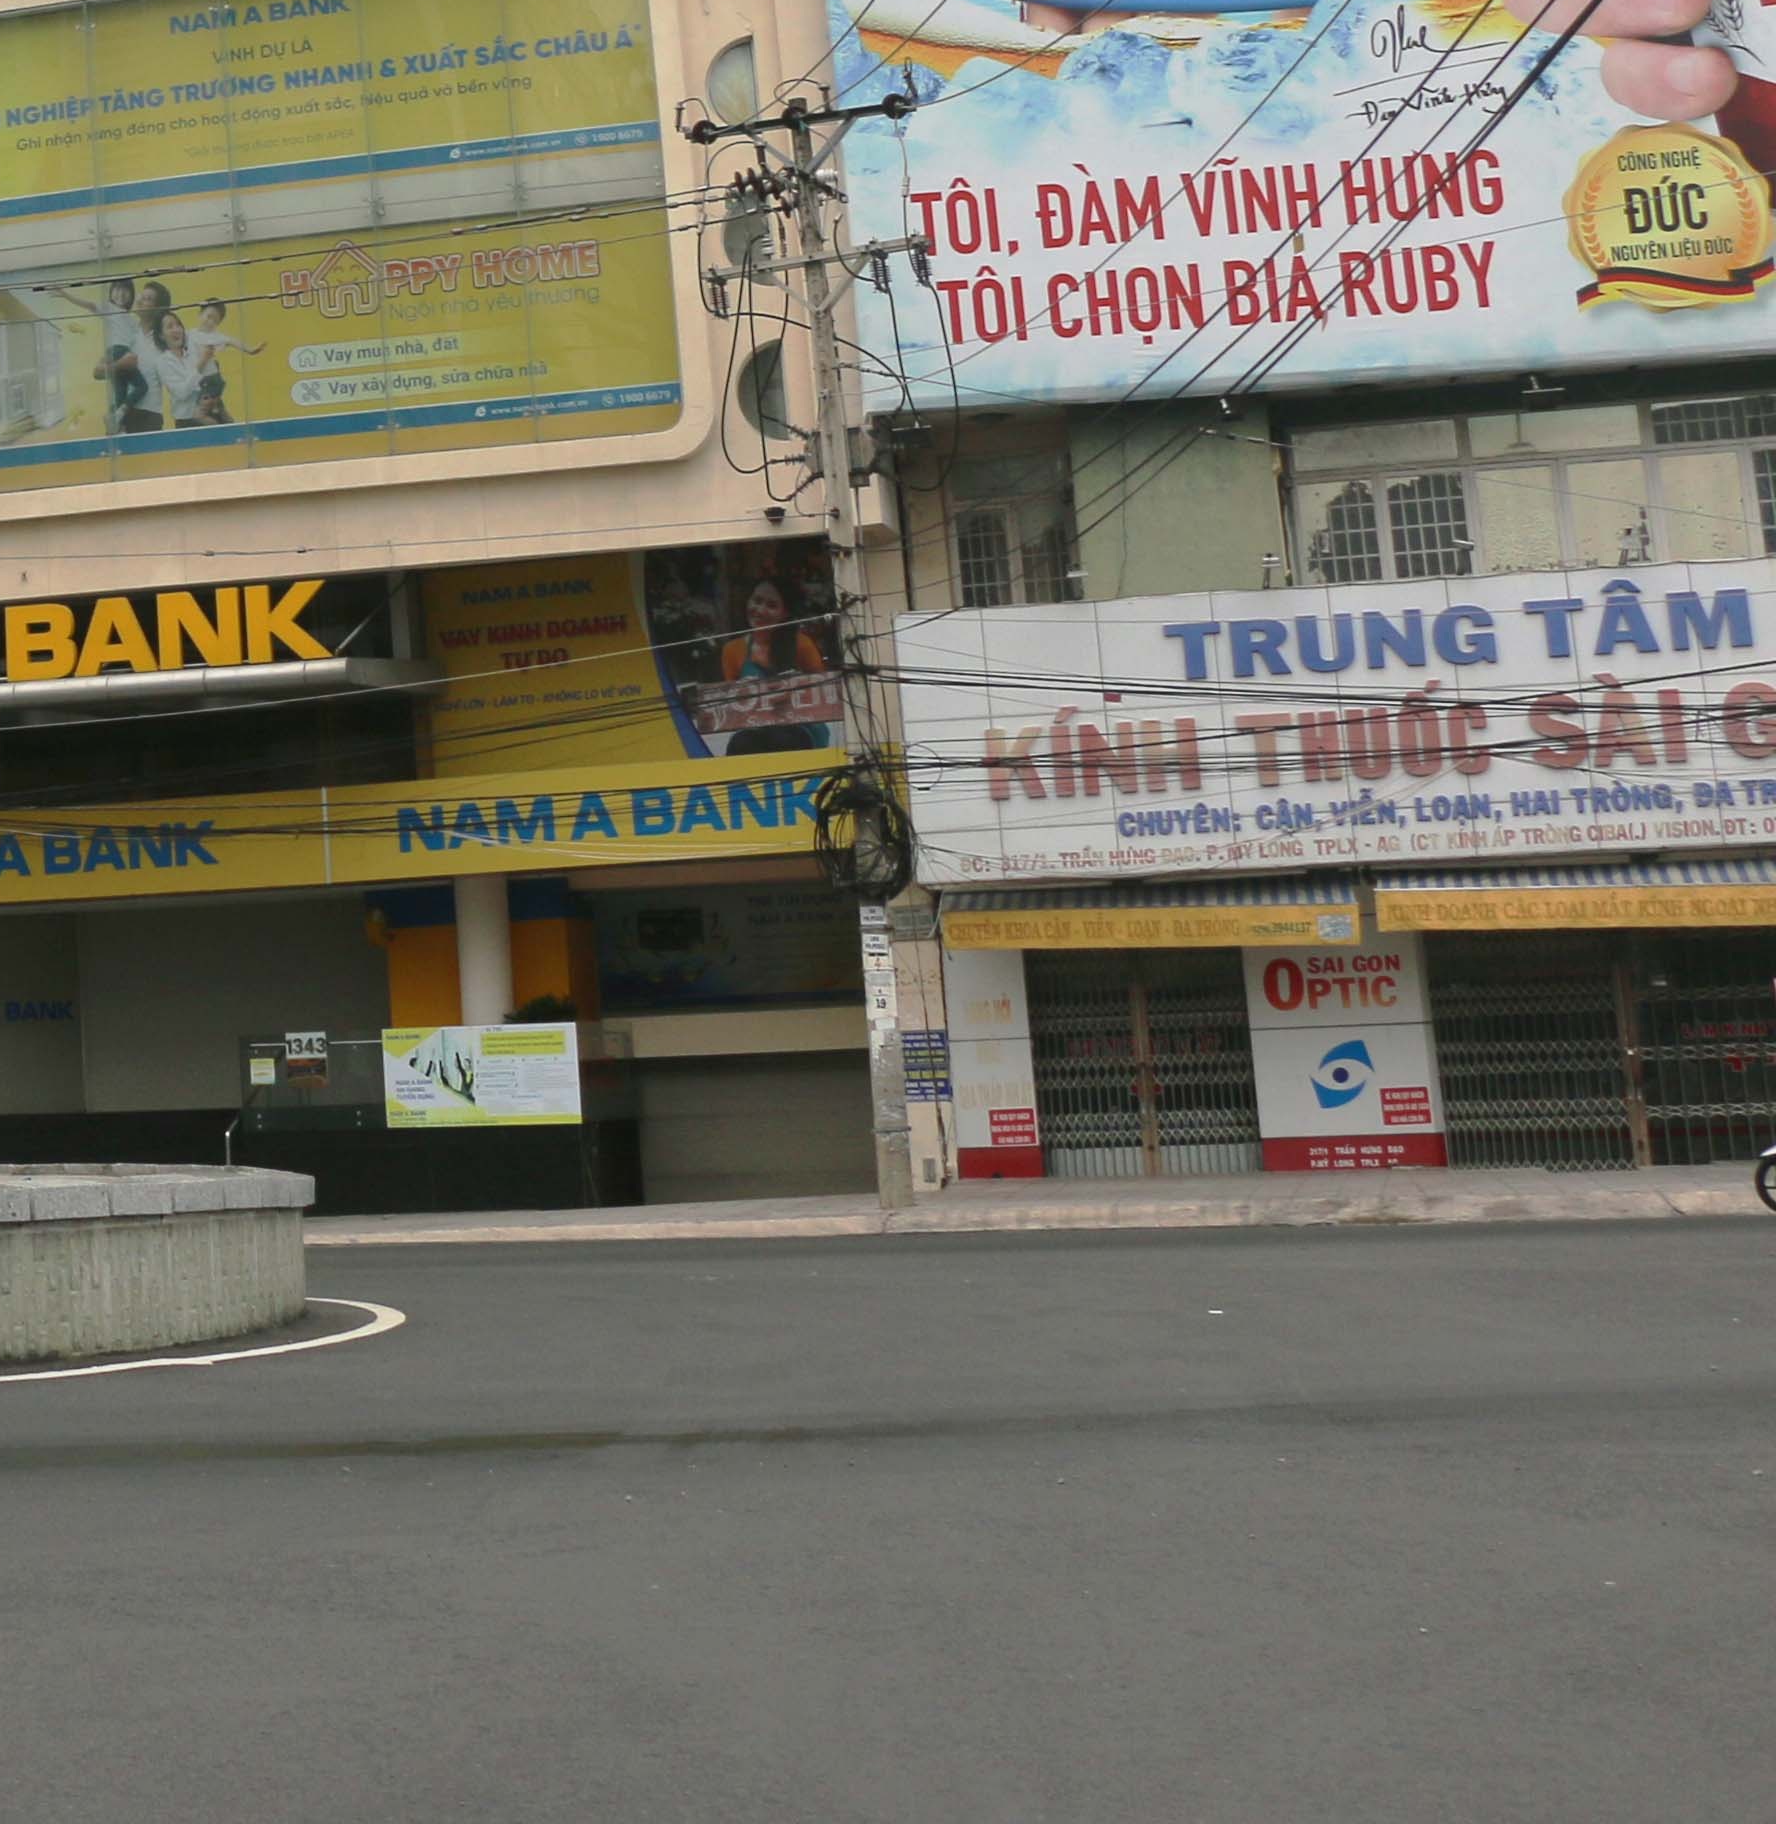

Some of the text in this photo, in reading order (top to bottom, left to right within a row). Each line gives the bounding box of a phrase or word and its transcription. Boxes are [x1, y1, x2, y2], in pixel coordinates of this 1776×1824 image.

[169, 7, 236, 37] NAM
[242, 3, 263, 26] A
[5, 99, 94, 129] NGHIỆP
[100, 87, 165, 114] TĂNG
[283, 61, 373, 91] NHANH
[404, 42, 467, 74] XUẤT
[475, 34, 527, 66] SẮC
[534, 28, 607, 59] CHÂU
[17, 136, 42, 152] Ghi
[169, 115, 197, 131] cho
[1617, 145, 1702, 172] CÔNG NGHỆ
[910, 179, 1019, 257] TÔI,
[1036, 164, 1166, 249] ĐÀM
[1180, 156, 1323, 238] VĨNH
[1623, 176, 1709, 235] ĐỨC
[471, 238, 602, 290] HOME
[1611, 242, 1667, 263] NGUYÊN
[1672, 240, 1701, 265] LIỆU
[936, 240, 1496, 346] TÔI CHỌN BIA RUBY
[323, 347, 352, 365] Vay
[328, 379, 356, 397] Vay
[5, 580, 335, 683] BANK
[1163, 578, 1755, 681] TRUNG TÂM
[983, 706, 1202, 802] KÍNH
[1528, 672, 1688, 771] SÀI
[397, 777, 824, 855] NAM A BANK
[1118, 801, 1241, 837] CHUYÊN:
[1415, 793, 1502, 833] LOẠN,
[1510, 789, 1560, 817] HAI
[1570, 779, 1684, 816] TRÒNG,
[42, 820, 219, 876] BANK
[1258, 841, 1304, 860] LONG
[1263, 957, 1398, 1012] OPTIC
[1307, 953, 1402, 974] SAI GON
[286, 1038, 327, 1056] 1343
